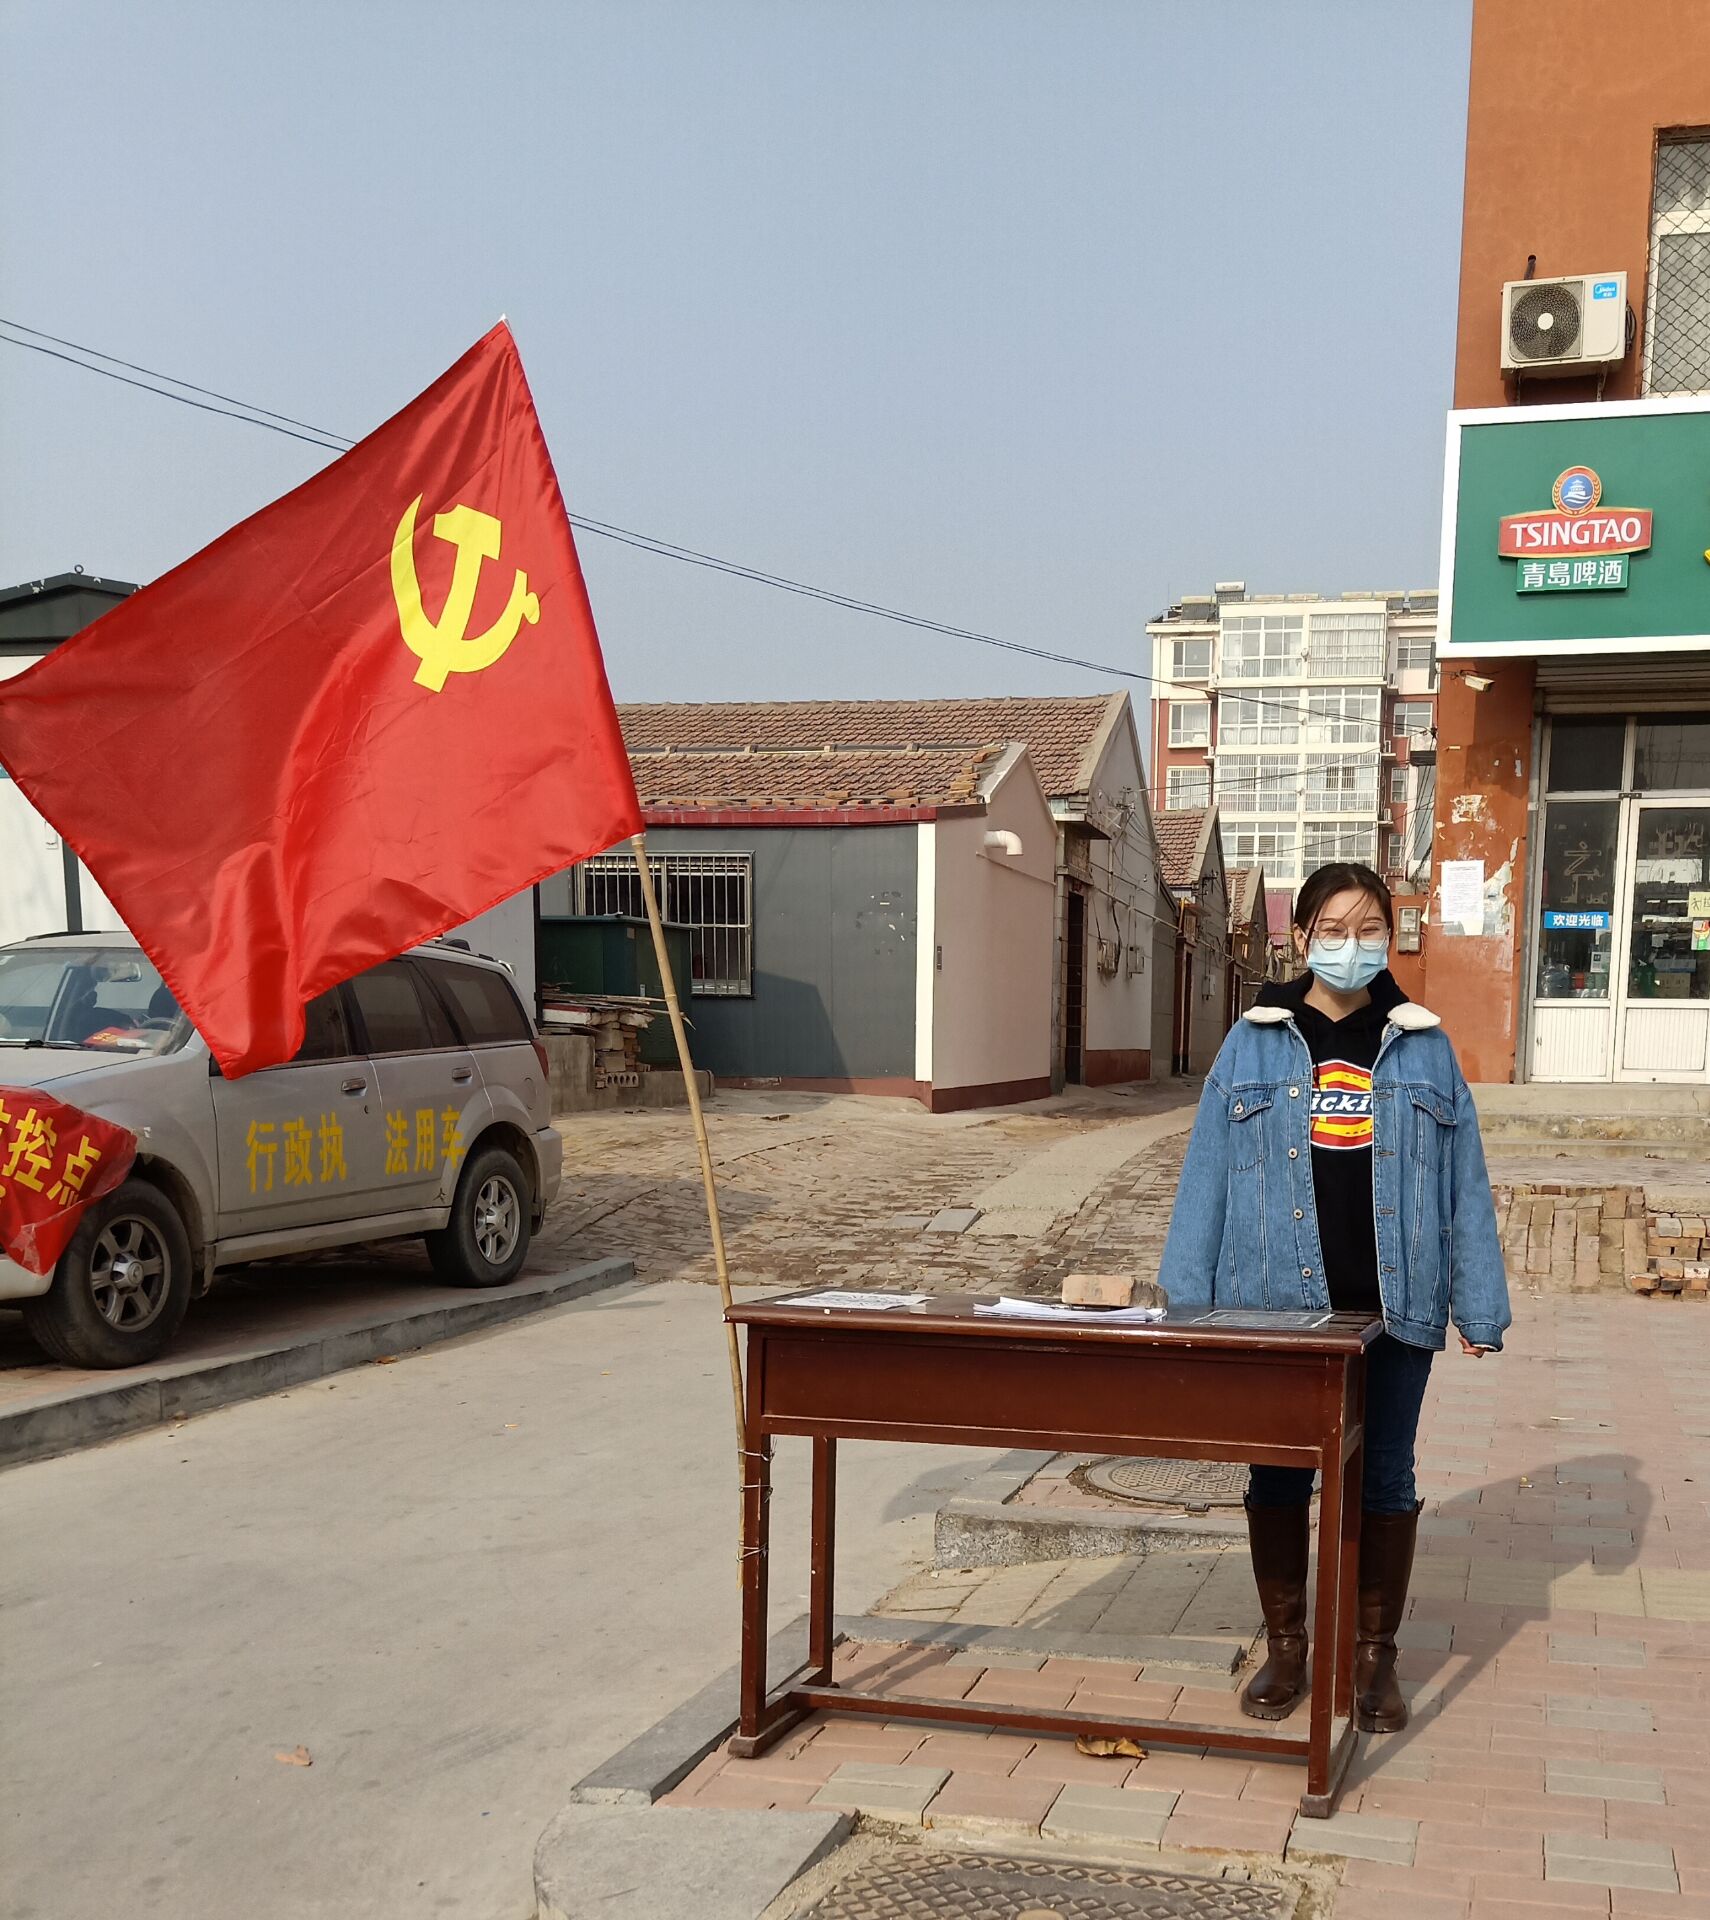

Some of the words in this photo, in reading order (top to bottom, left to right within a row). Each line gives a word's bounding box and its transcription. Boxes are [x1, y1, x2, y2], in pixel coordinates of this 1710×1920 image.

[1509, 517, 1642, 548] TSINGTAO
[1552, 914, 1604, 927] 欢迎光临
[1310, 1093, 1374, 1112] icki
